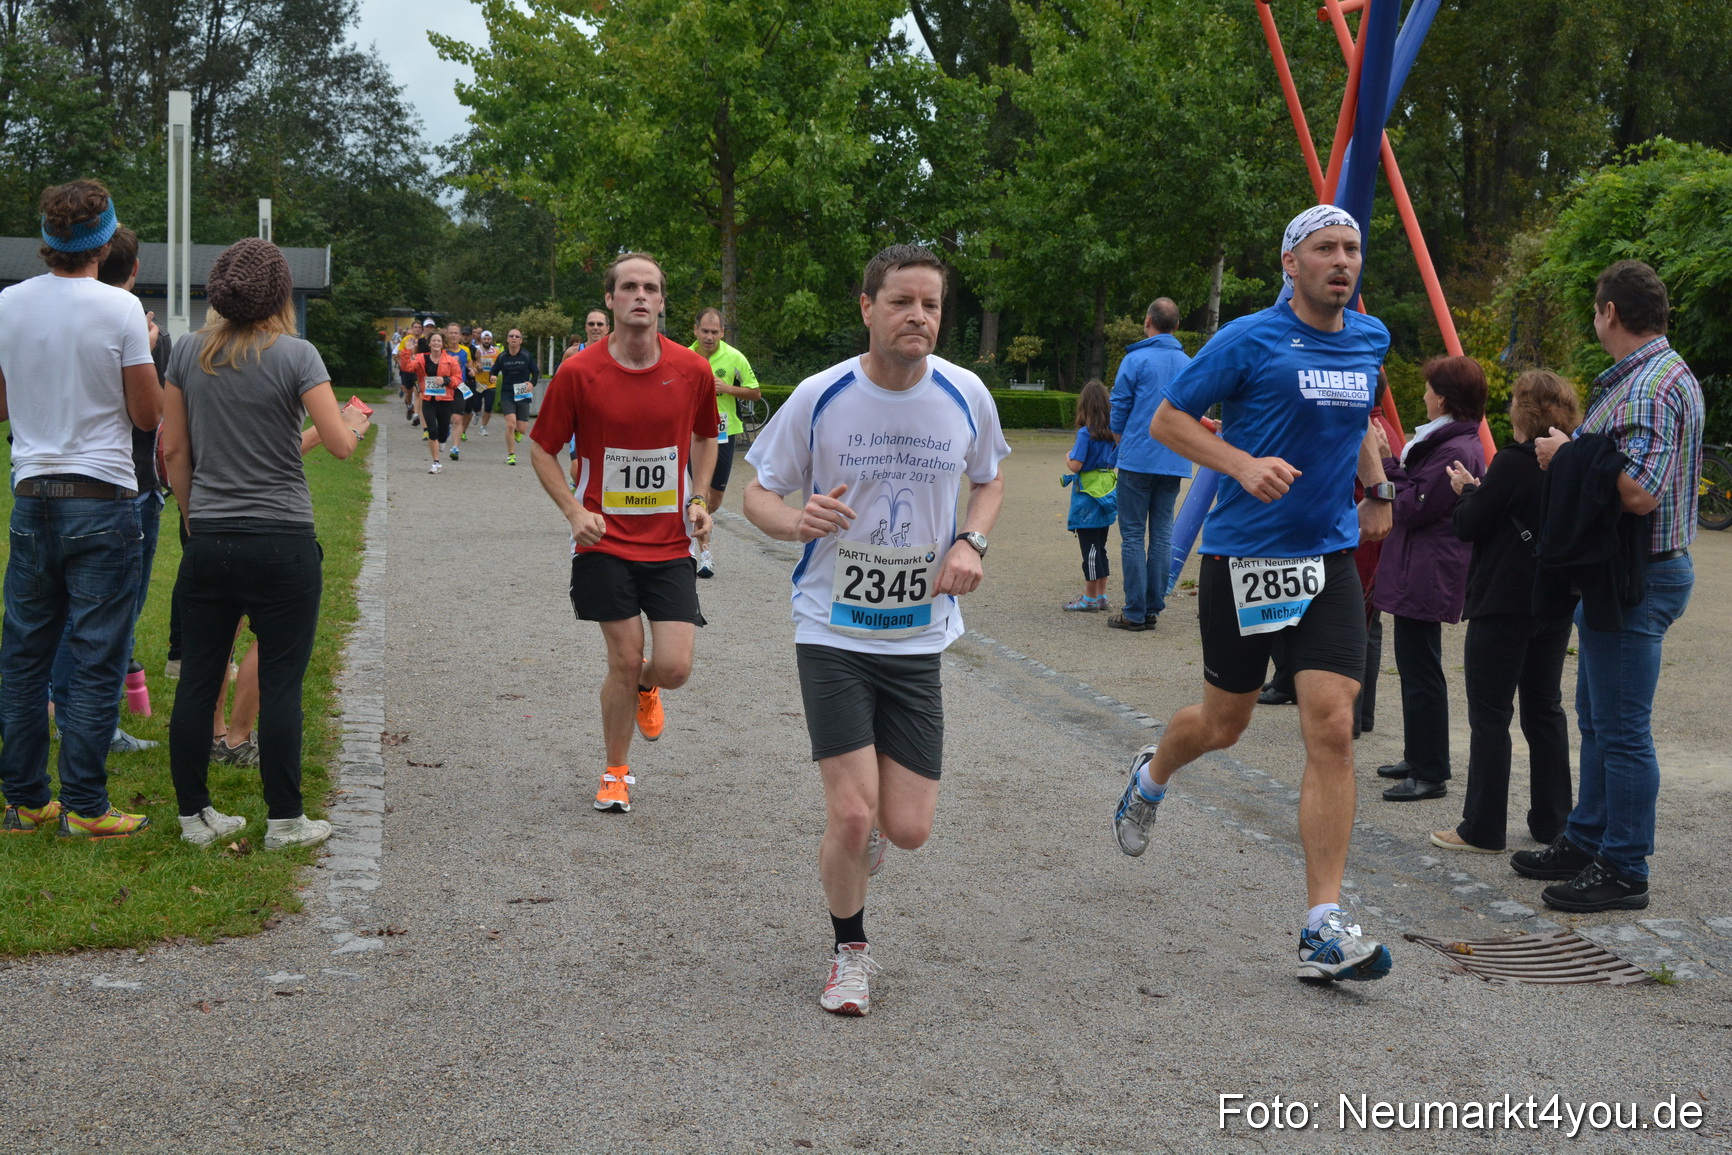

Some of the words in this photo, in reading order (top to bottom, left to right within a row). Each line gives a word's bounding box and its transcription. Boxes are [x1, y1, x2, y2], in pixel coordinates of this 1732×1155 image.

[1298, 370, 1369, 390] HUBER
[1317, 390, 1367, 398] TECHNOLOGY
[848, 434, 866, 447] 19.
[869, 432, 952, 452] Johannesbad
[605, 454, 631, 463] PARTL
[632, 455, 667, 463] Neumarkt
[838, 452, 956, 472] Thermen-Marathon
[620, 465, 665, 489] 109
[859, 470, 869, 481] 5.
[871, 469, 907, 480] Februar
[909, 471, 936, 484] 2012
[625, 495, 657, 505] Martin
[838, 548, 872, 563] PARTL
[873, 555, 922, 566] Neumarkt
[1231, 560, 1262, 569] PARTL
[1264, 558, 1308, 567] Neumarkt
[843, 565, 927, 604] 2345
[1242, 565, 1319, 603] 2856
[851, 609, 914, 629] Wolfgang
[1261, 602, 1304, 621] Michael
